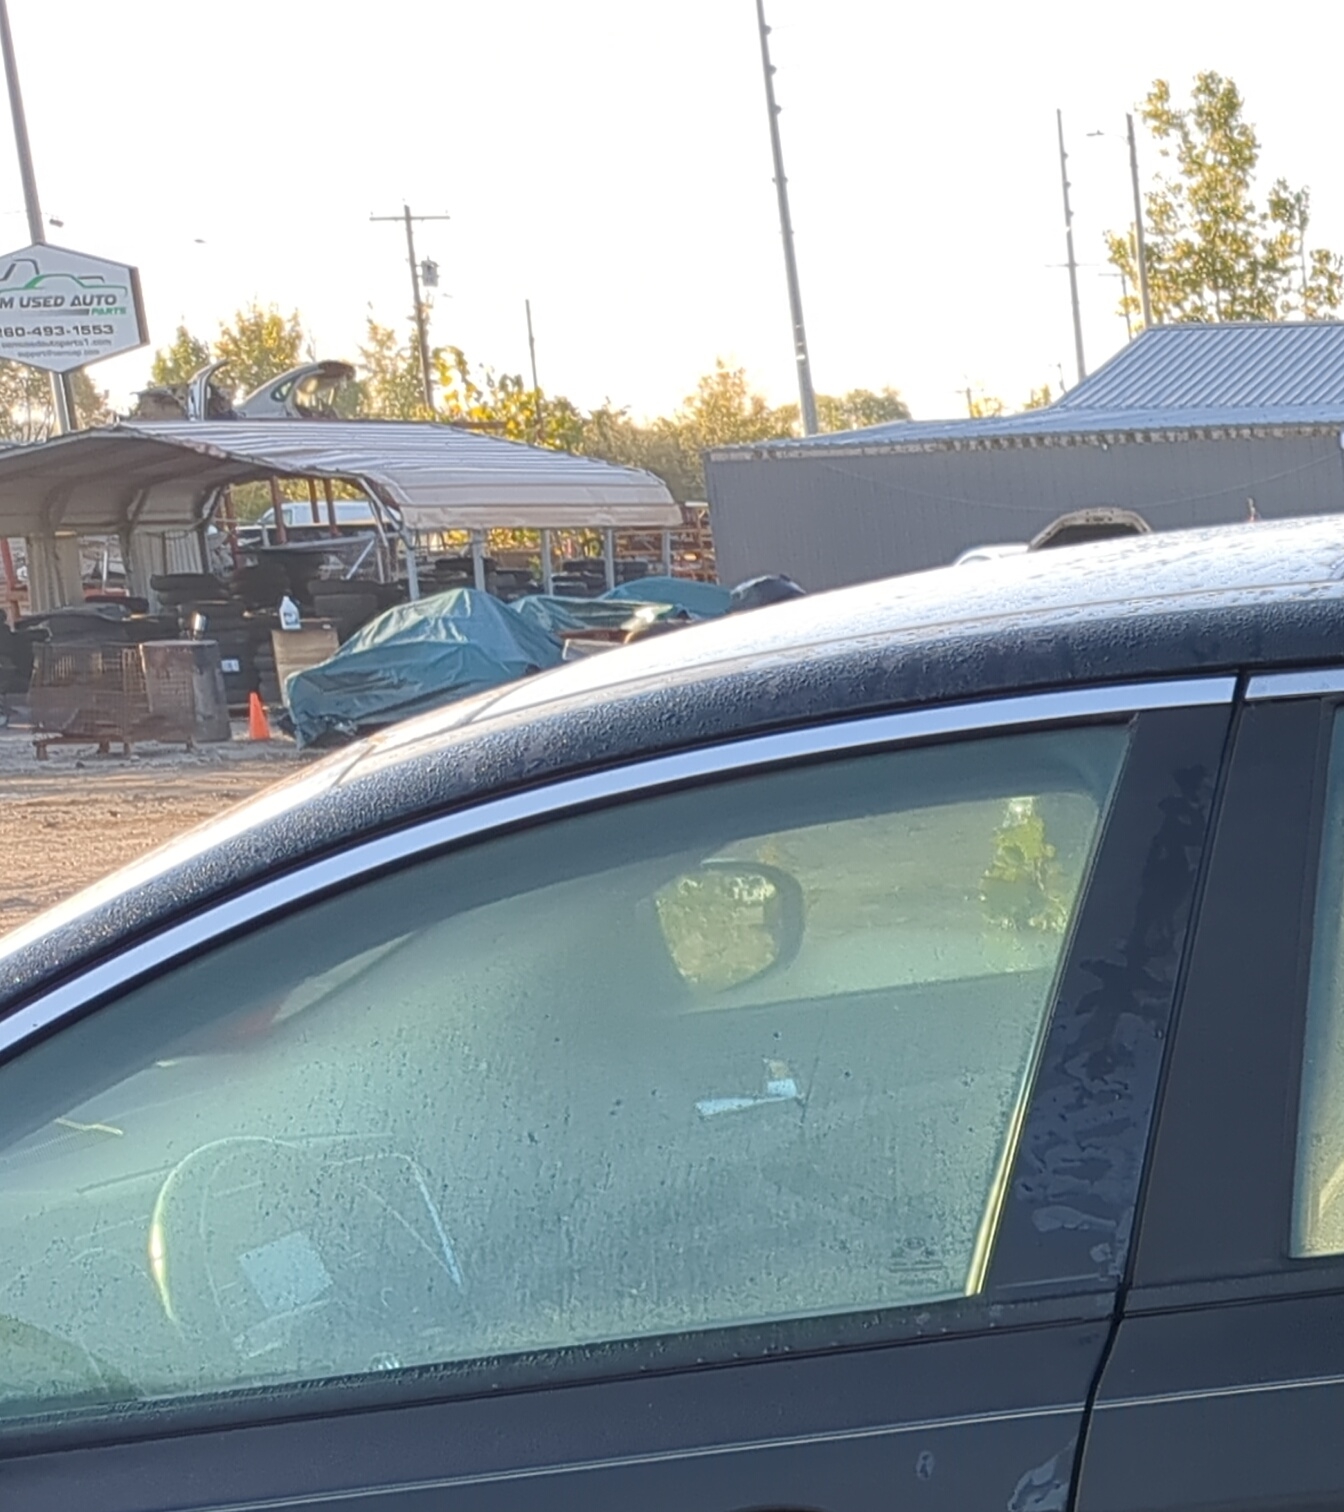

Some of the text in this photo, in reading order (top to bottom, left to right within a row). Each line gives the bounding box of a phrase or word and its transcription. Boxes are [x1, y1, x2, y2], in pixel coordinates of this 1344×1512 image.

[20, 295, 65, 309] USED
[70, 294, 117, 307] AUTO
[91, 307, 127, 315] PARTS
[0, 324, 114, 338] 60-493-1553
